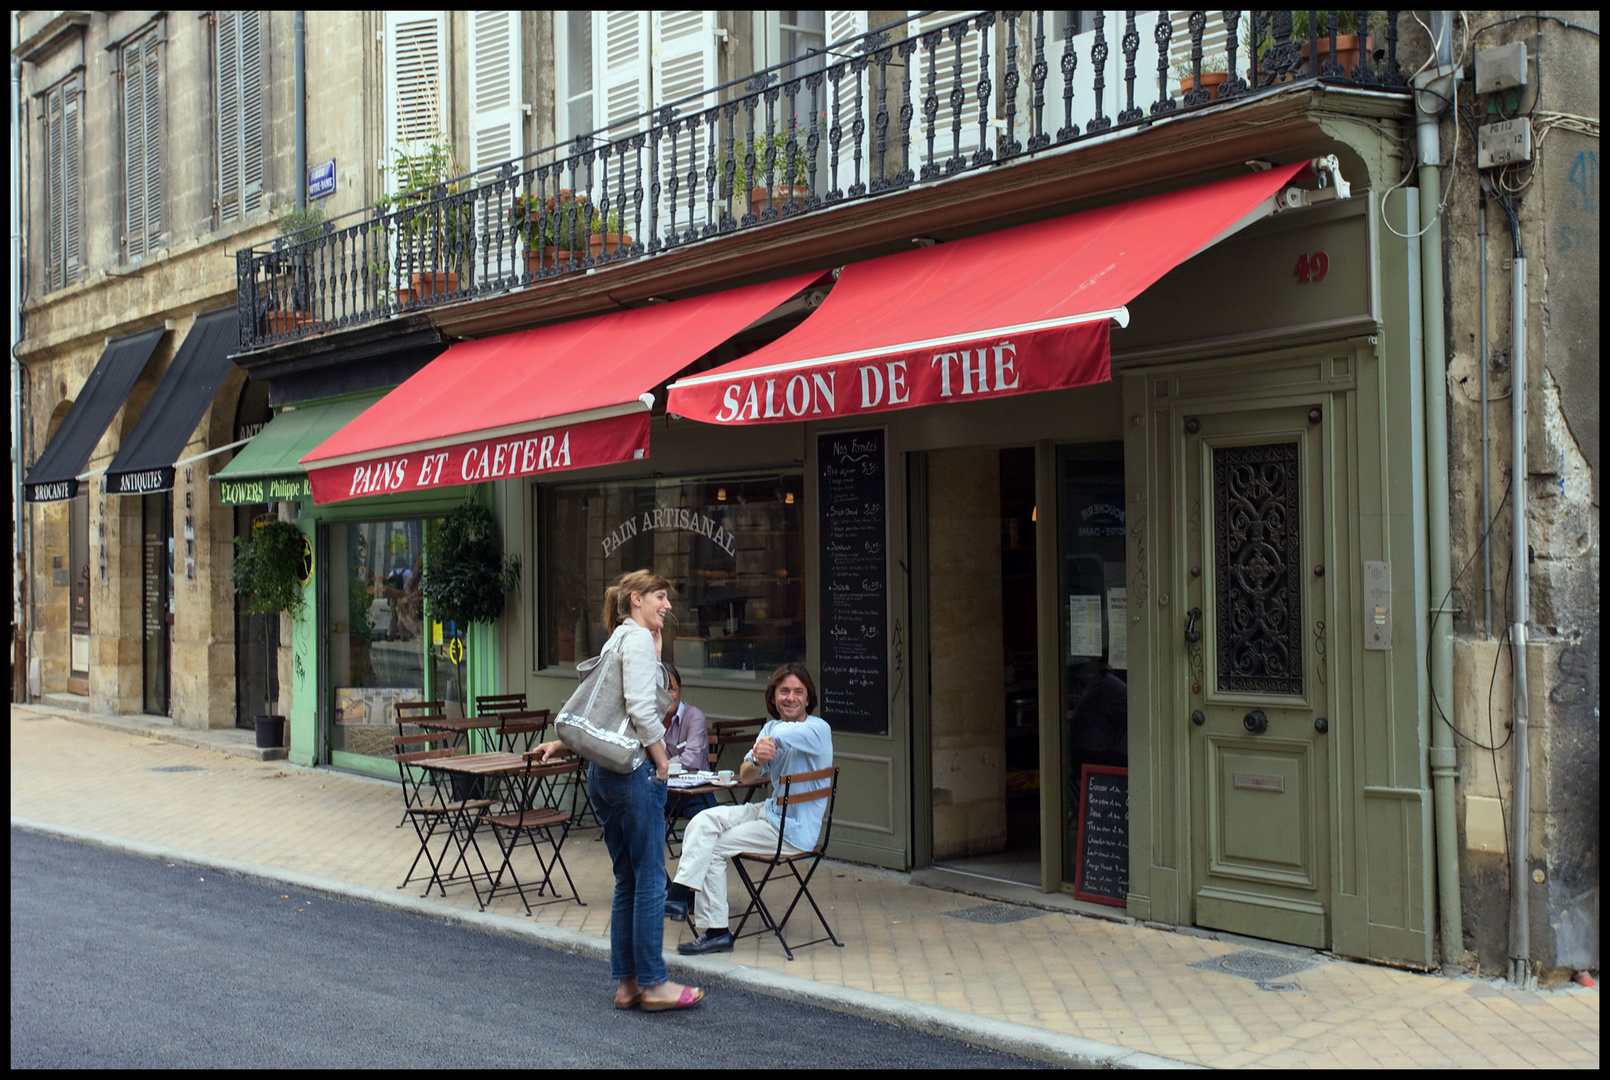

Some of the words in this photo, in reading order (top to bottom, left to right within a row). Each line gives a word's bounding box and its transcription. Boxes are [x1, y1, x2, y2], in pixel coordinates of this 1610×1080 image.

[1514, 134, 1523, 144] 12
[1293, 251, 1330, 285] 49
[716, 371, 836, 422] SALON
[859, 360, 910, 409] DE
[931, 341, 1020, 397] THÉ
[350, 458, 408, 496] PAINS
[416, 452, 449, 487] ET
[461, 431, 572, 482] CAETERA
[34, 481, 69, 501] BROCANTE
[221, 481, 264, 504] FLOWERS
[270, 479, 300, 500] Philippe
[184, 467, 194, 581] VENTE
[601, 516, 637, 559] PAIN
[641, 507, 736, 558] ARTISANAL
